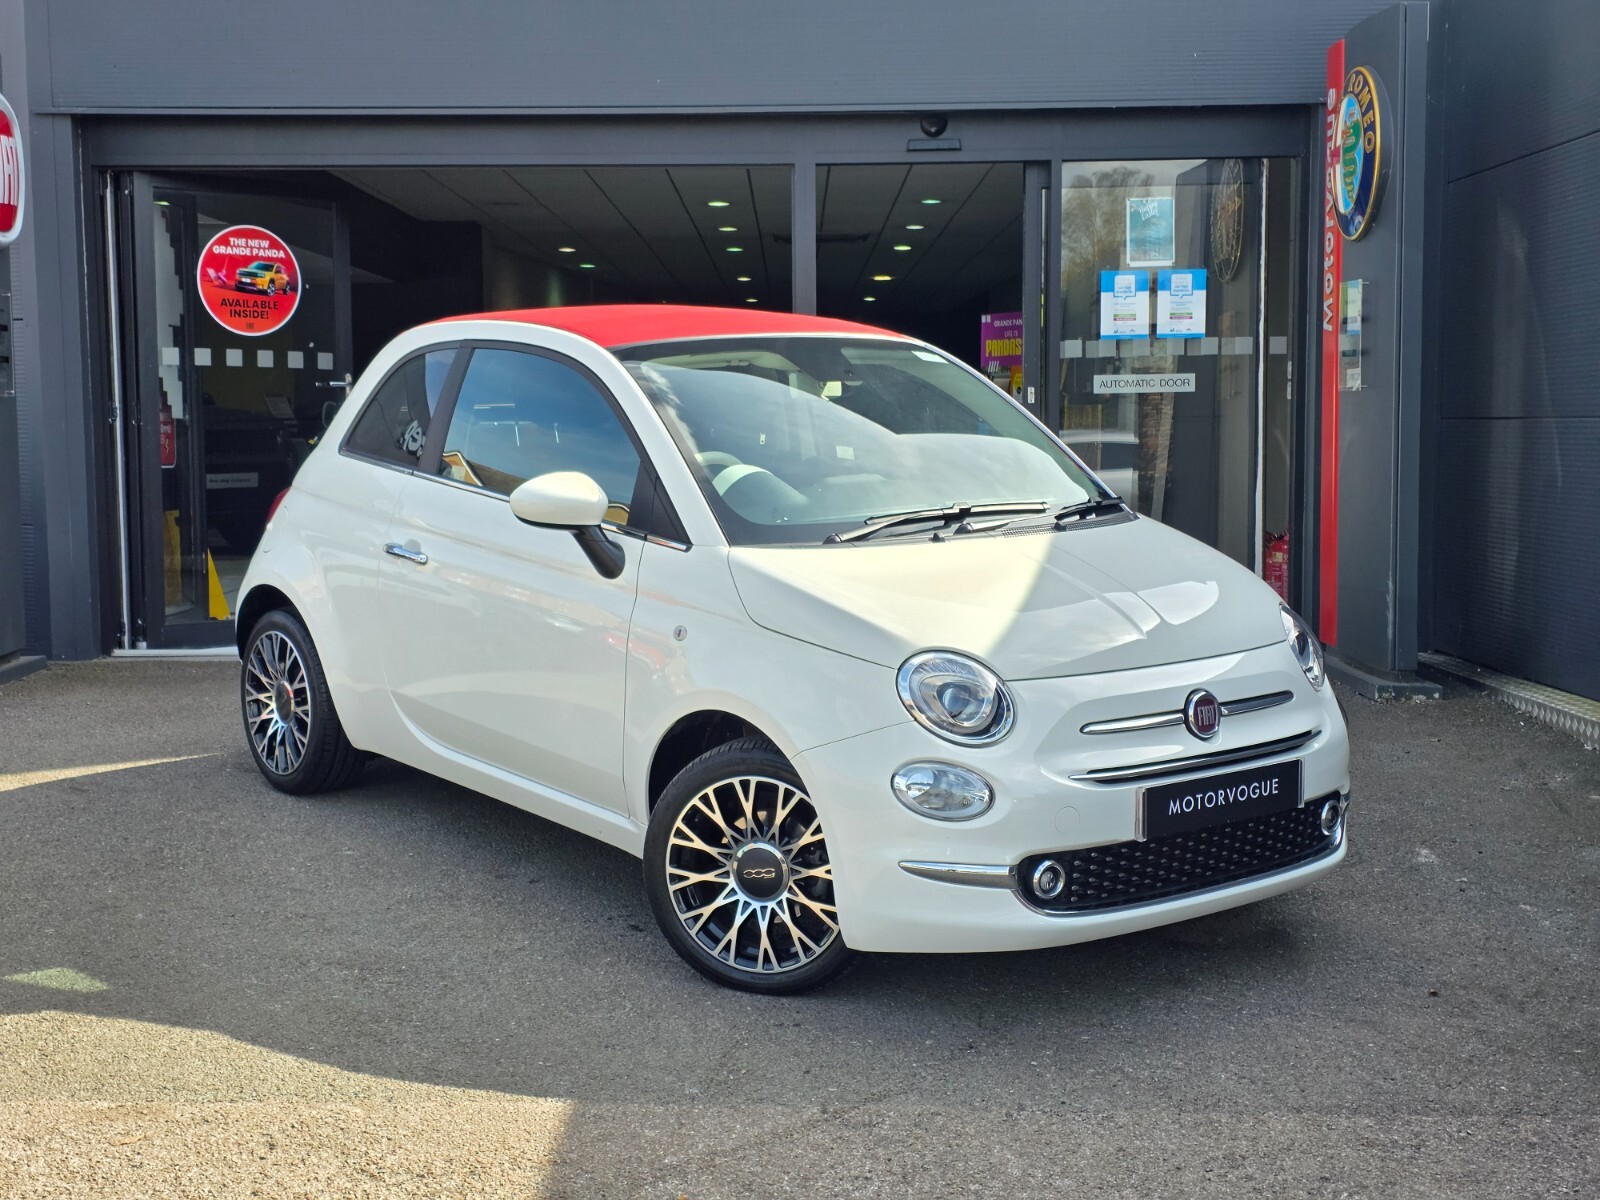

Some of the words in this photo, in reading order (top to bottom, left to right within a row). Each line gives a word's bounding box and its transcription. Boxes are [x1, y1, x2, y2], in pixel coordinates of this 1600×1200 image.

[1348, 73, 1375, 154] ROMEO
[229, 237, 247, 247] THE
[247, 239, 270, 249] NEW
[212, 245, 251, 256] GRANDE
[252, 248, 286, 258] PANDA
[220, 298, 279, 310] AVAILABLE
[229, 309, 269, 319] INSIDE!
[1099, 379, 1156, 389] AUTOMATIC
[1159, 378, 1191, 388] DOOR
[1197, 705, 1215, 726] FIAT
[1168, 778, 1279, 816] MOTORVOGUE
